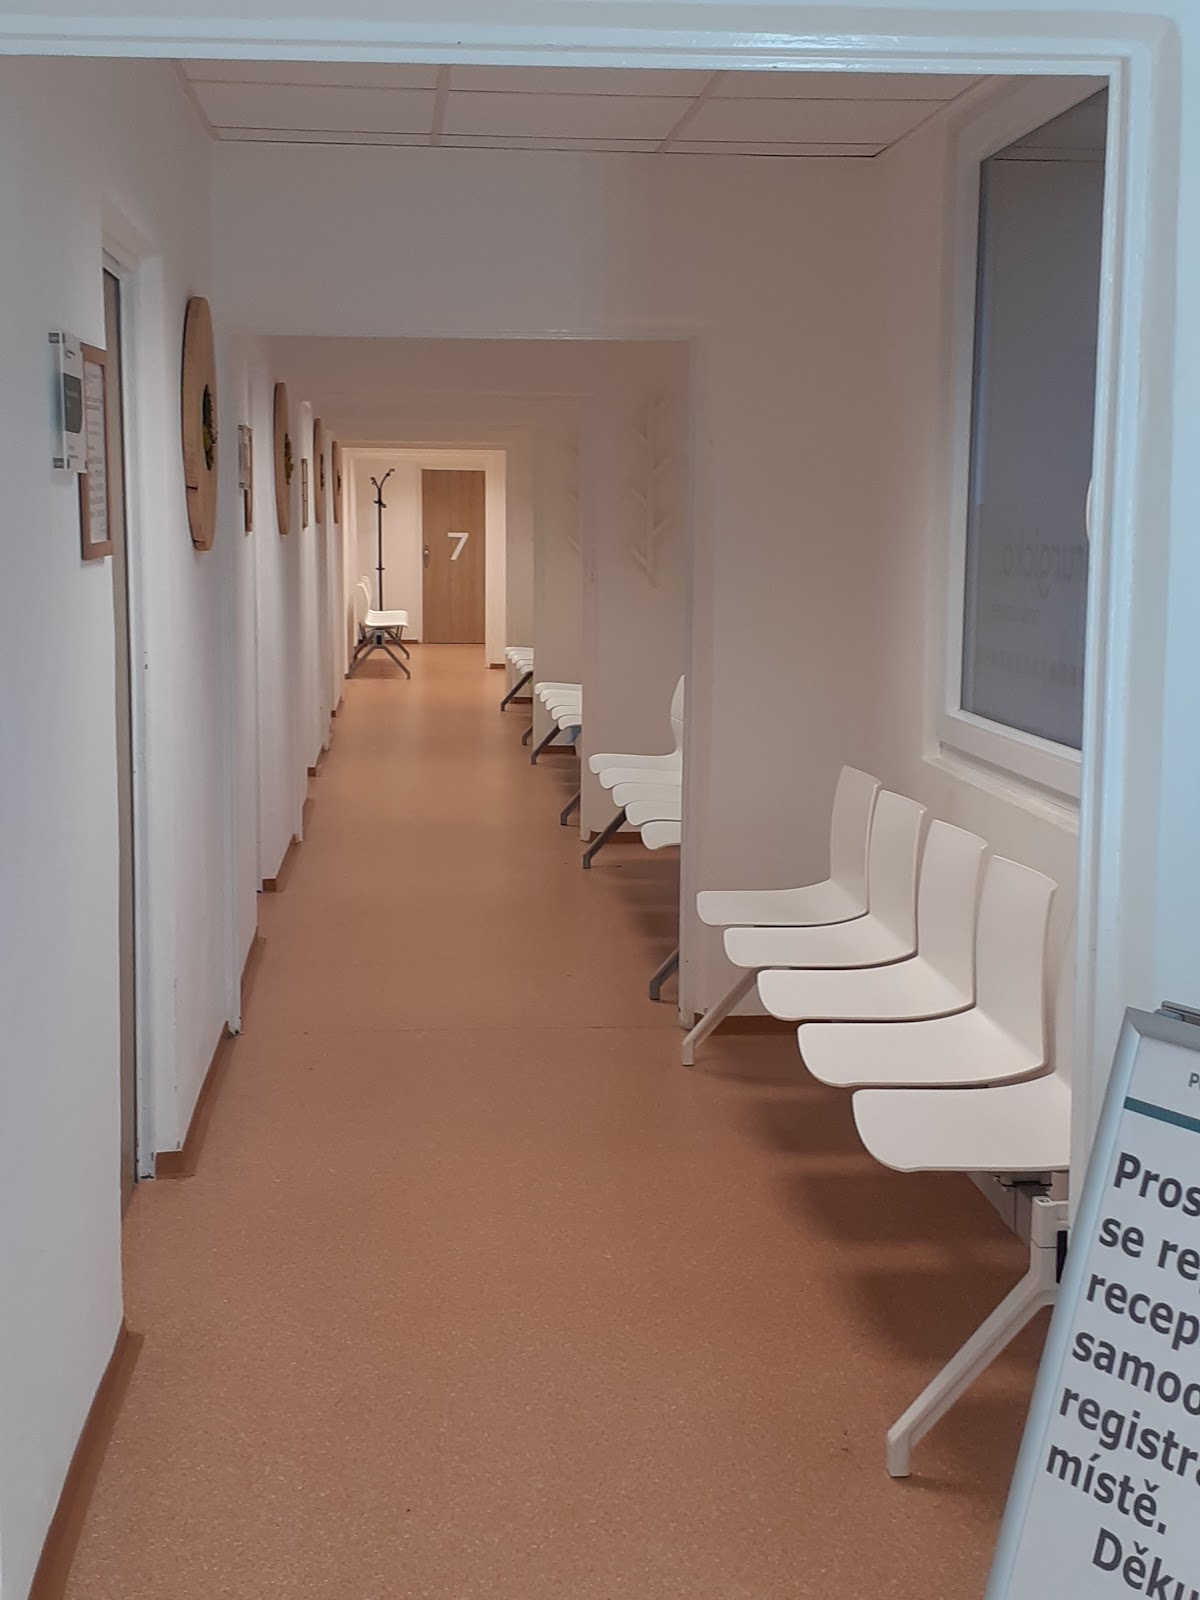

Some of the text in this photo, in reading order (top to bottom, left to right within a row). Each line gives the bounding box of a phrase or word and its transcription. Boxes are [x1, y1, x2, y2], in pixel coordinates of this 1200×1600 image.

[447, 532, 469, 560] 7
[1188, 1072, 1200, 1090] P
[1113, 1152, 1200, 1217] Pros
[1099, 1217, 1200, 1286] se re
[1086, 1273, 1200, 1351] recep
[1059, 1387, 1200, 1487] registr
[1046, 1444, 1167, 1535] místě.
